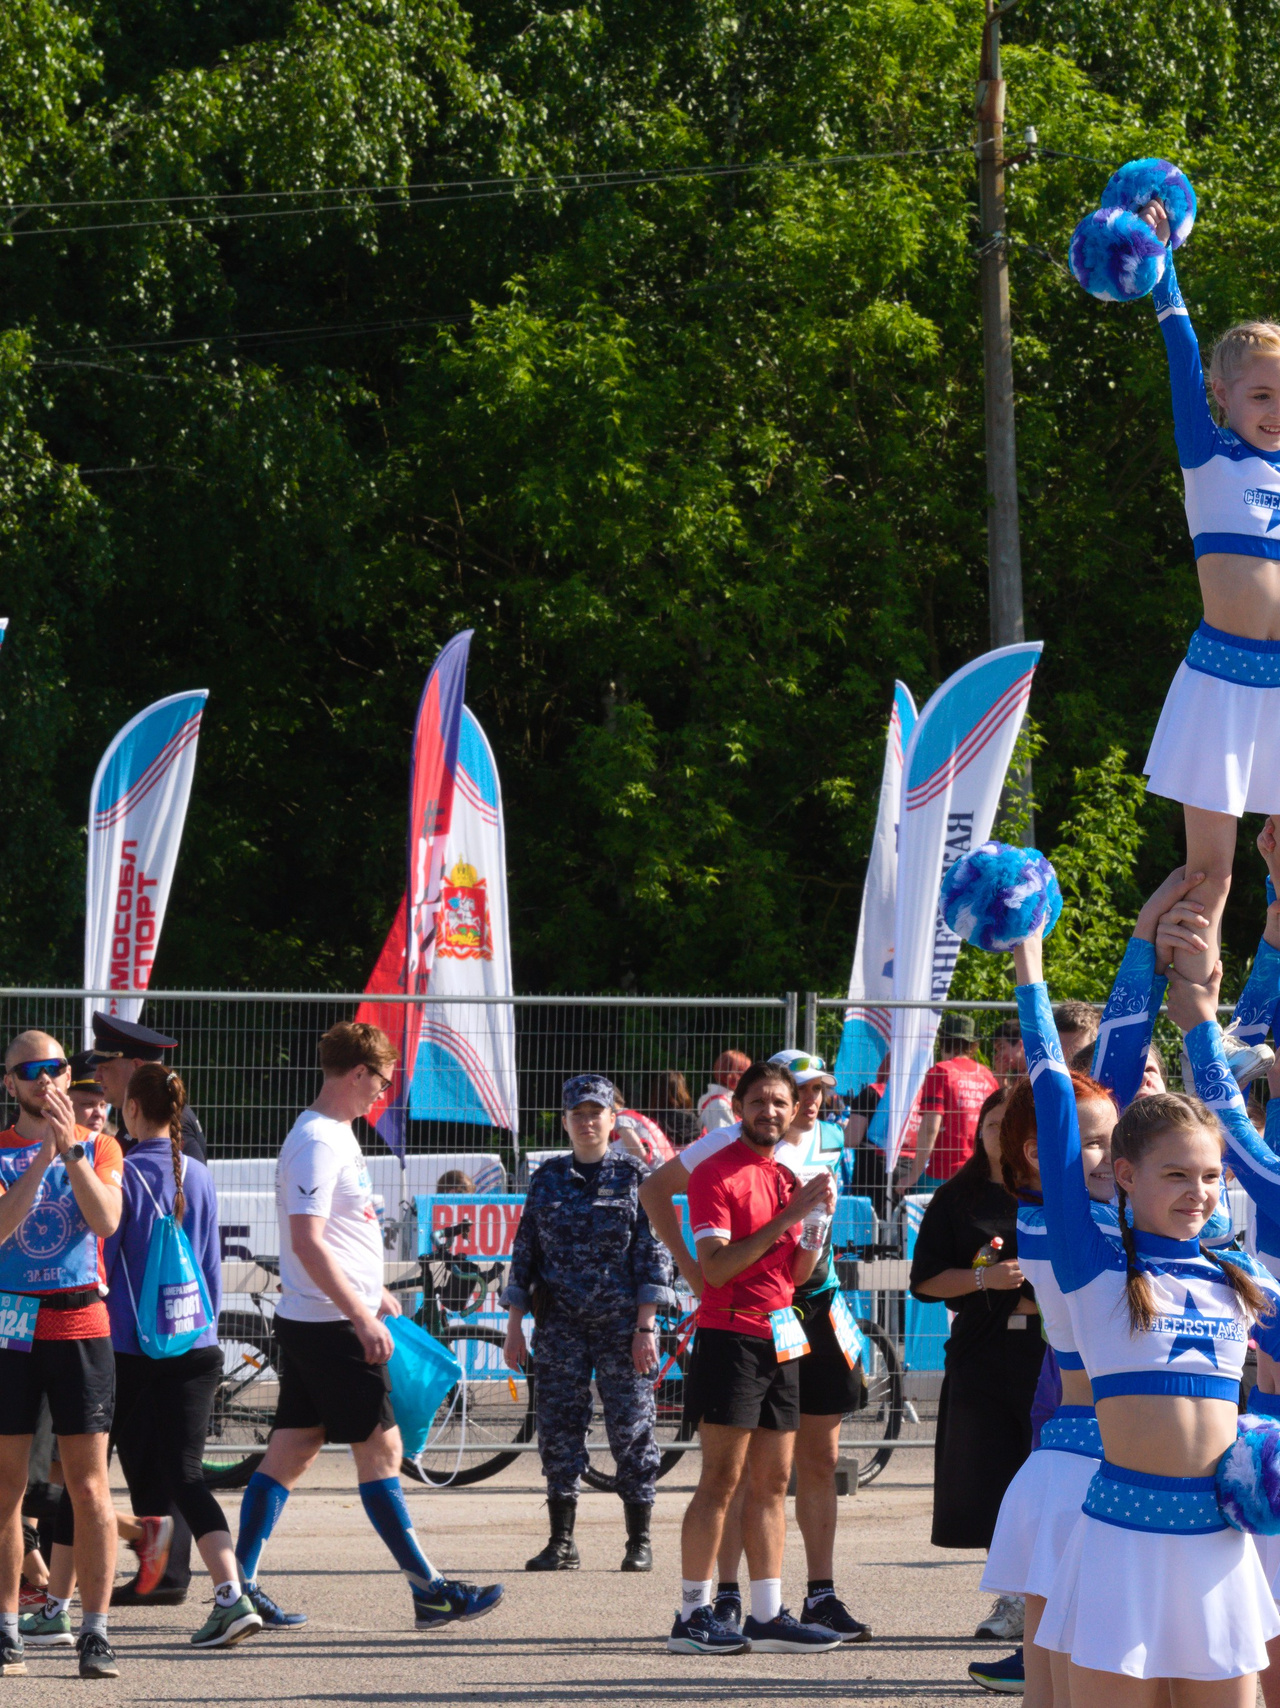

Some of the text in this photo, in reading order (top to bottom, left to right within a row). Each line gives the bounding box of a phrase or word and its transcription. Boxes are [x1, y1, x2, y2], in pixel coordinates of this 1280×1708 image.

[110, 840, 138, 990] МОСОБЛ
[133, 872, 158, 990] СПОРТ
[165, 1293, 200, 1319] 50081
[1135, 1314, 1245, 1342] HEERSTARS
